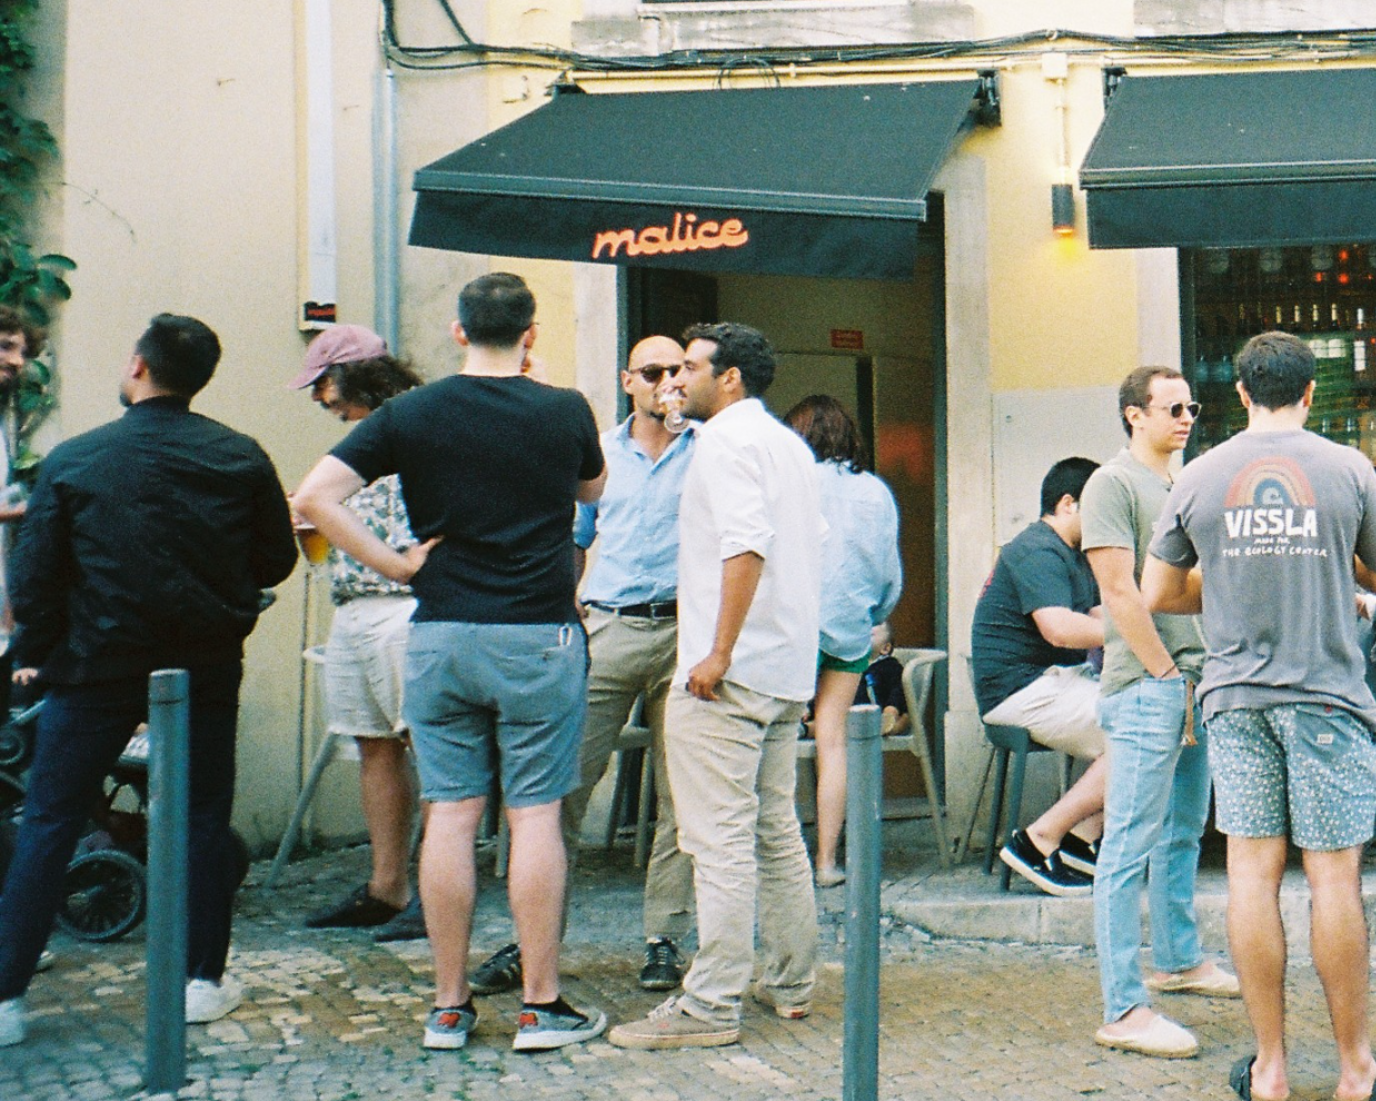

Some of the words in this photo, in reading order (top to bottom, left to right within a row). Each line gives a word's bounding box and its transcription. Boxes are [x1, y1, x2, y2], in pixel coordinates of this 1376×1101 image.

[592, 211, 749, 259] malice
[1224, 508, 1318, 538] VISSLA
[1222, 547, 1241, 557] THE
[1244, 545, 1287, 556] ECOLOGY
